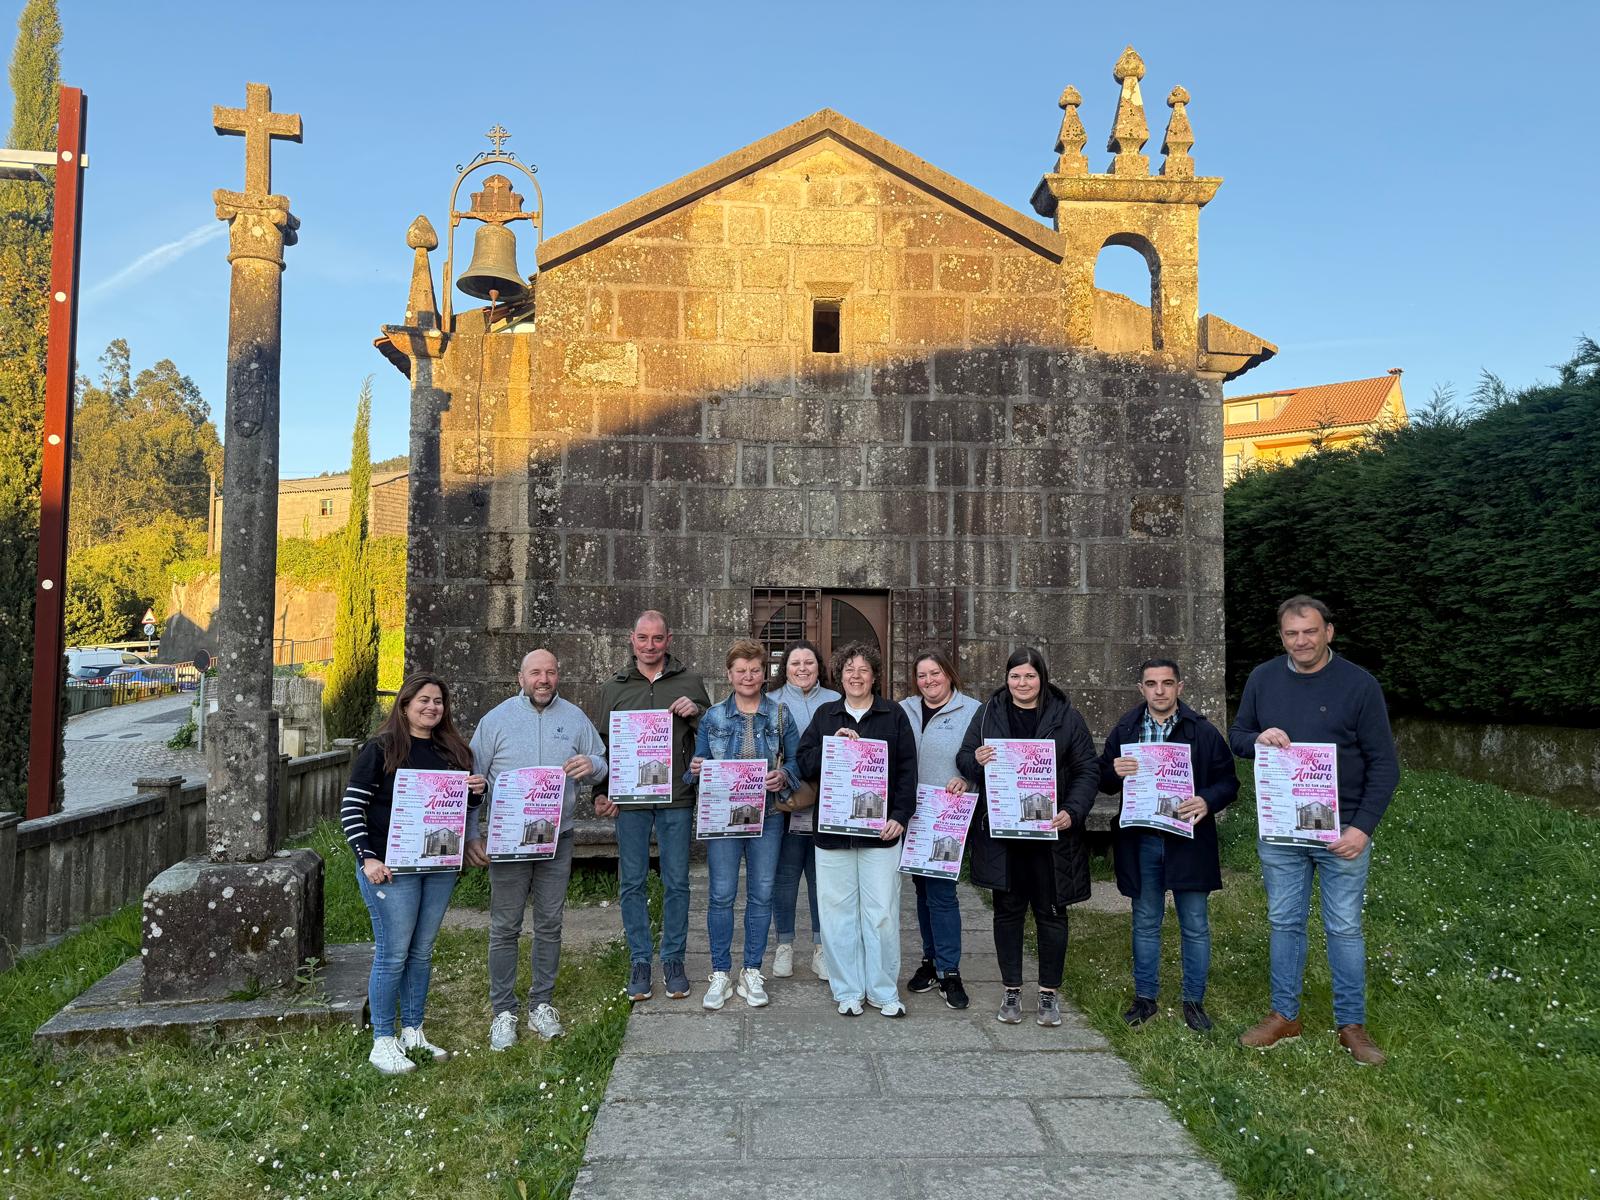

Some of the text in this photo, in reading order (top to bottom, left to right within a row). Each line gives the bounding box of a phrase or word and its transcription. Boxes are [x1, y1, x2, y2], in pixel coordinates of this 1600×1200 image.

[652, 724, 668, 734] San
[637, 732, 668, 744] Amaro
[868, 754, 884, 764] San
[1033, 754, 1051, 766] San
[1307, 749, 1329, 760] Feira
[852, 761, 884, 773] Amaro
[1171, 757, 1188, 768] San
[1310, 760, 1331, 771] San
[1017, 763, 1051, 775] Amaro
[1155, 765, 1189, 777] Amaro
[746, 773, 763, 783] San
[1291, 768, 1332, 782] Amaro
[440, 776, 462, 789] Feira
[543, 780, 560, 791] San
[730, 781, 763, 792] Amaro
[443, 786, 463, 798] San
[525, 788, 559, 801] Amaro
[425, 795, 463, 809] Amaro
[954, 804, 971, 814] San
[937, 810, 968, 820] Amaro
